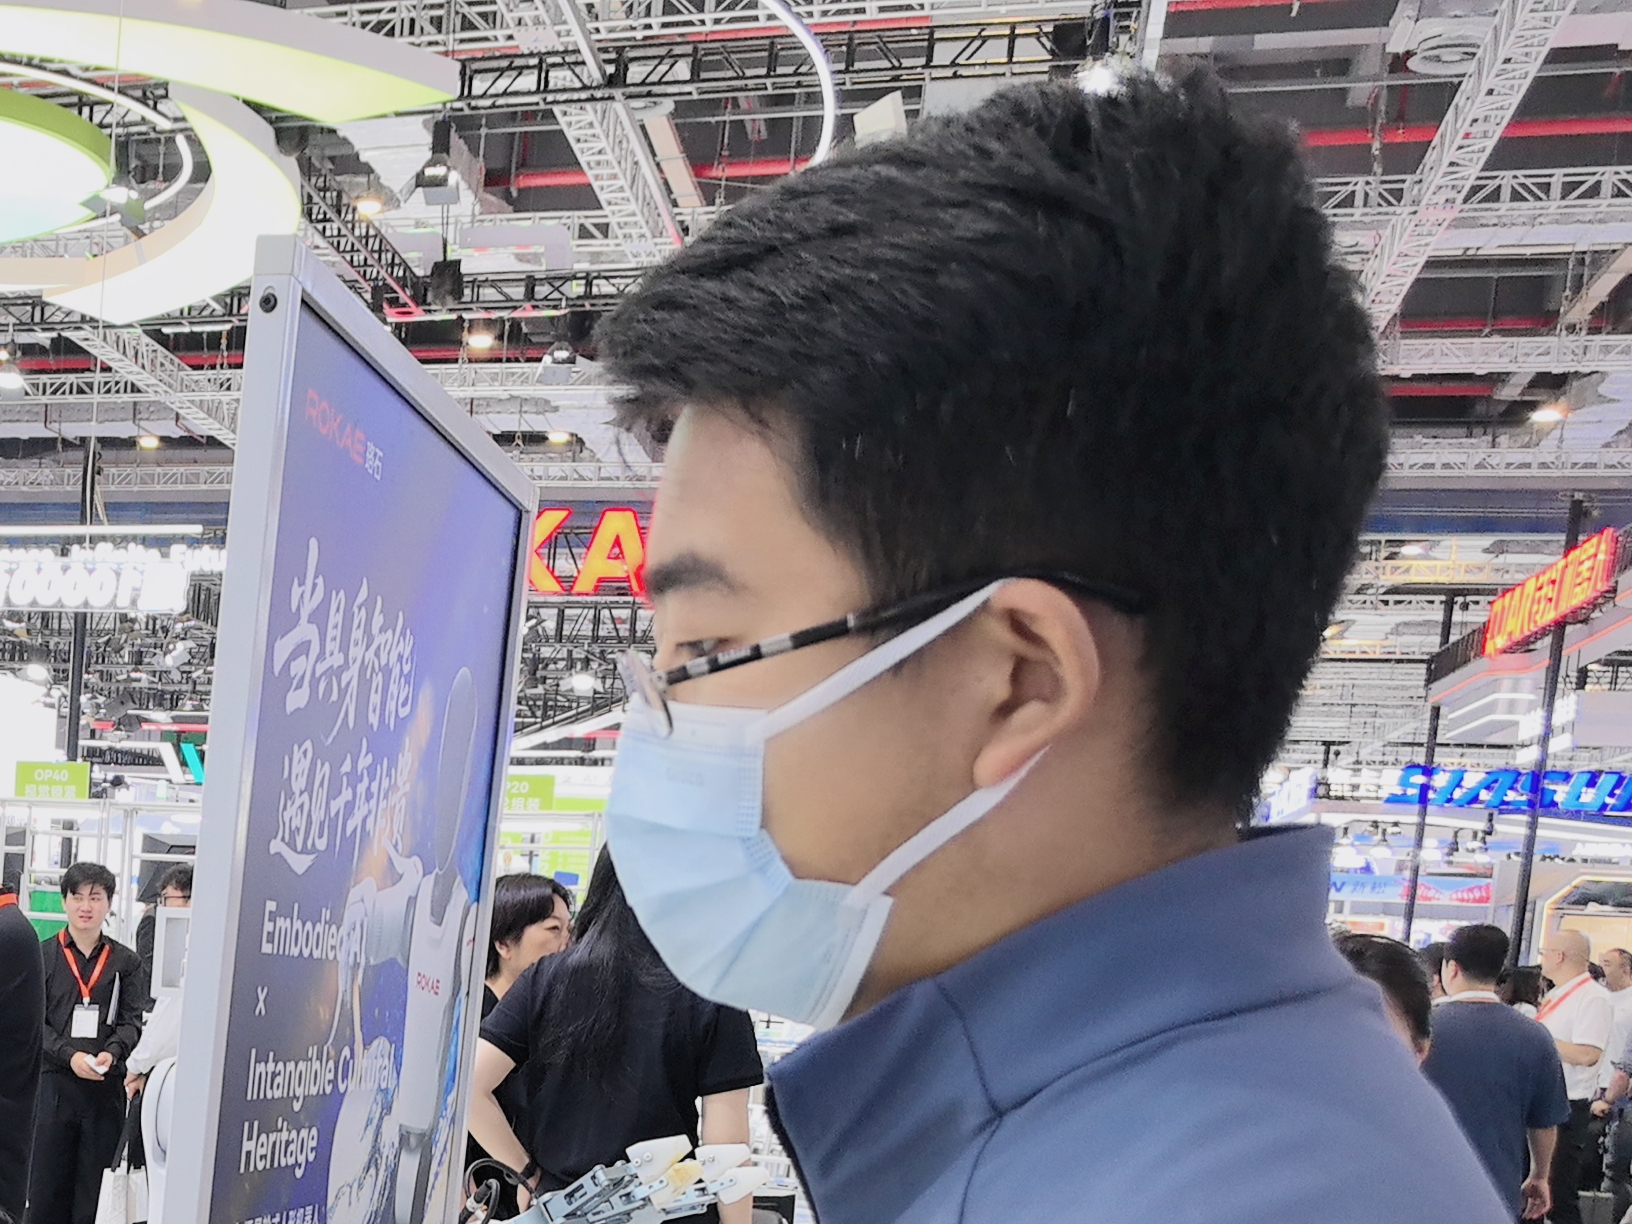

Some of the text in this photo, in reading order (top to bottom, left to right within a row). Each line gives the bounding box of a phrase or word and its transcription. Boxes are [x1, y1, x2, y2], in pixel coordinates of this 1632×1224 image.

[305, 388, 366, 466] ROKAE
[33, 769, 70, 782] OP40
[260, 898, 352, 962] Embodied
[416, 971, 441, 996] ROKAE
[246, 1043, 396, 1112] Intangible Cultural
[239, 1116, 318, 1179] Heritage
